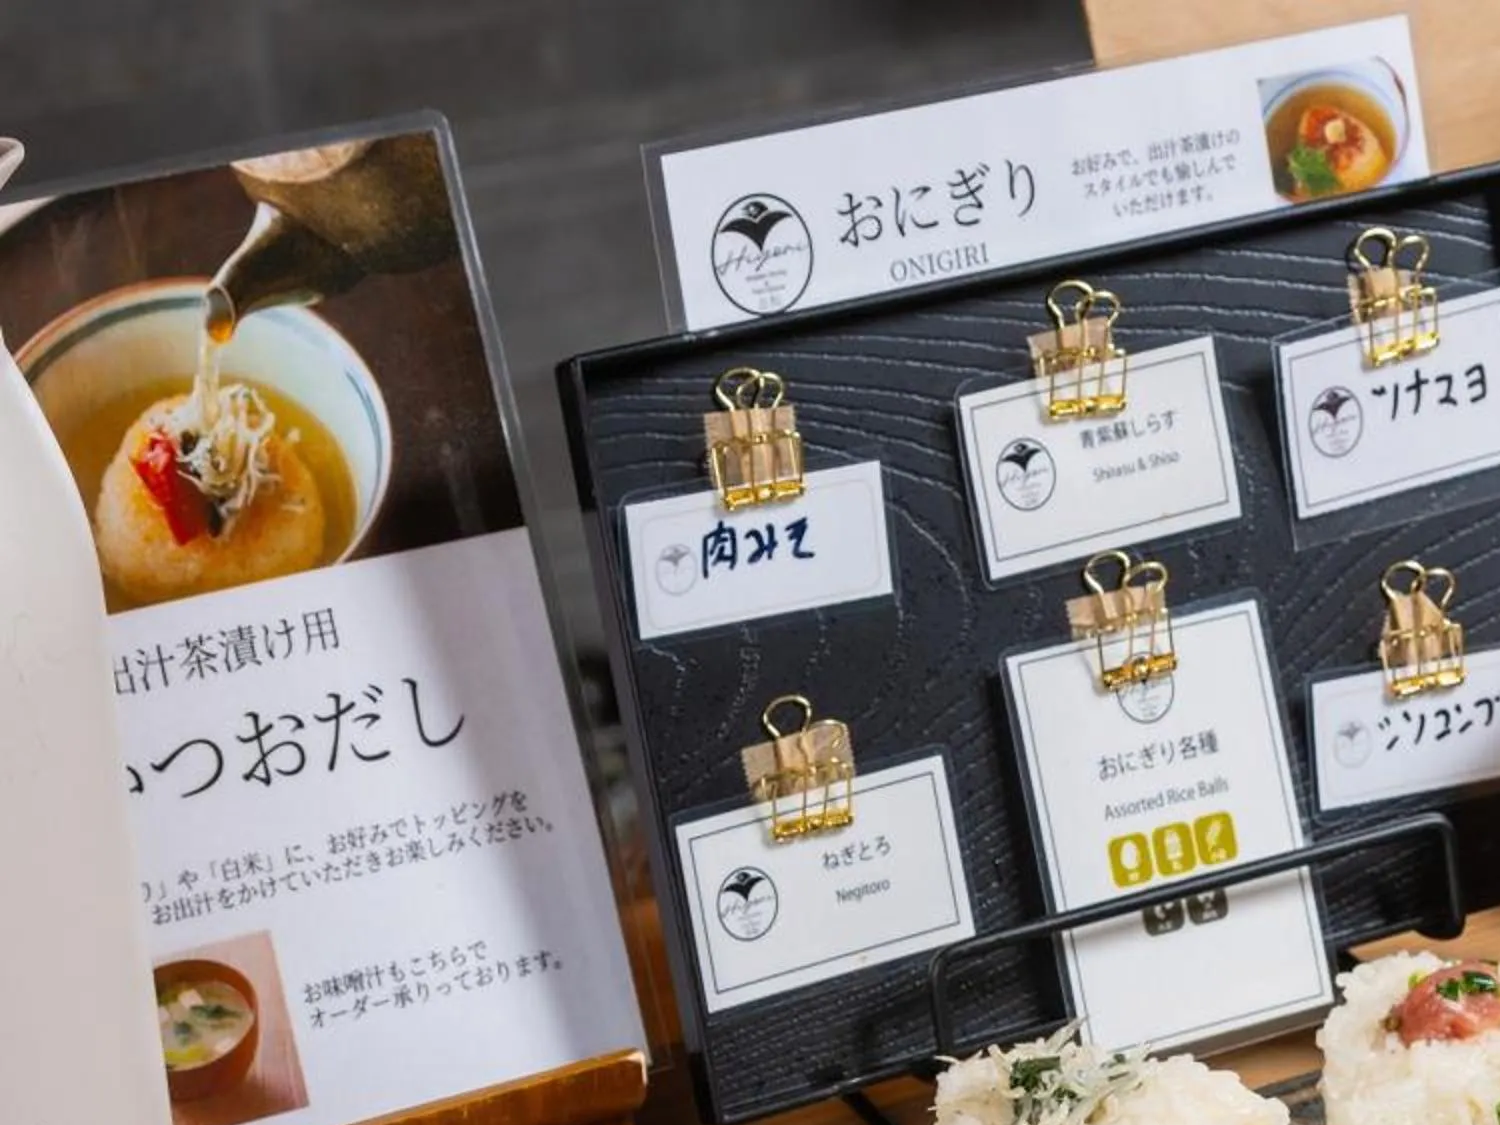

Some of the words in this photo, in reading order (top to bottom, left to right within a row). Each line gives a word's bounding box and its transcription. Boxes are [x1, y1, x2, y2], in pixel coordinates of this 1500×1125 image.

[837, 157, 1037, 248] おにぎり
[1113, 185, 1213, 217] いただけます。
[890, 242, 989, 282] ONIGIRI
[1137, 458, 1146, 473] &
[702, 517, 815, 579] 肉みそ
[1098, 730, 1219, 781] おにぎり各種
[1104, 791, 1163, 821] Assorted
[1167, 786, 1195, 803] Rice
[1198, 776, 1229, 798] Balls
[822, 836, 891, 871] ねぎとろ
[836, 878, 890, 903] Negitoro
[302, 940, 488, 1006] お味噌汁もこちらで
